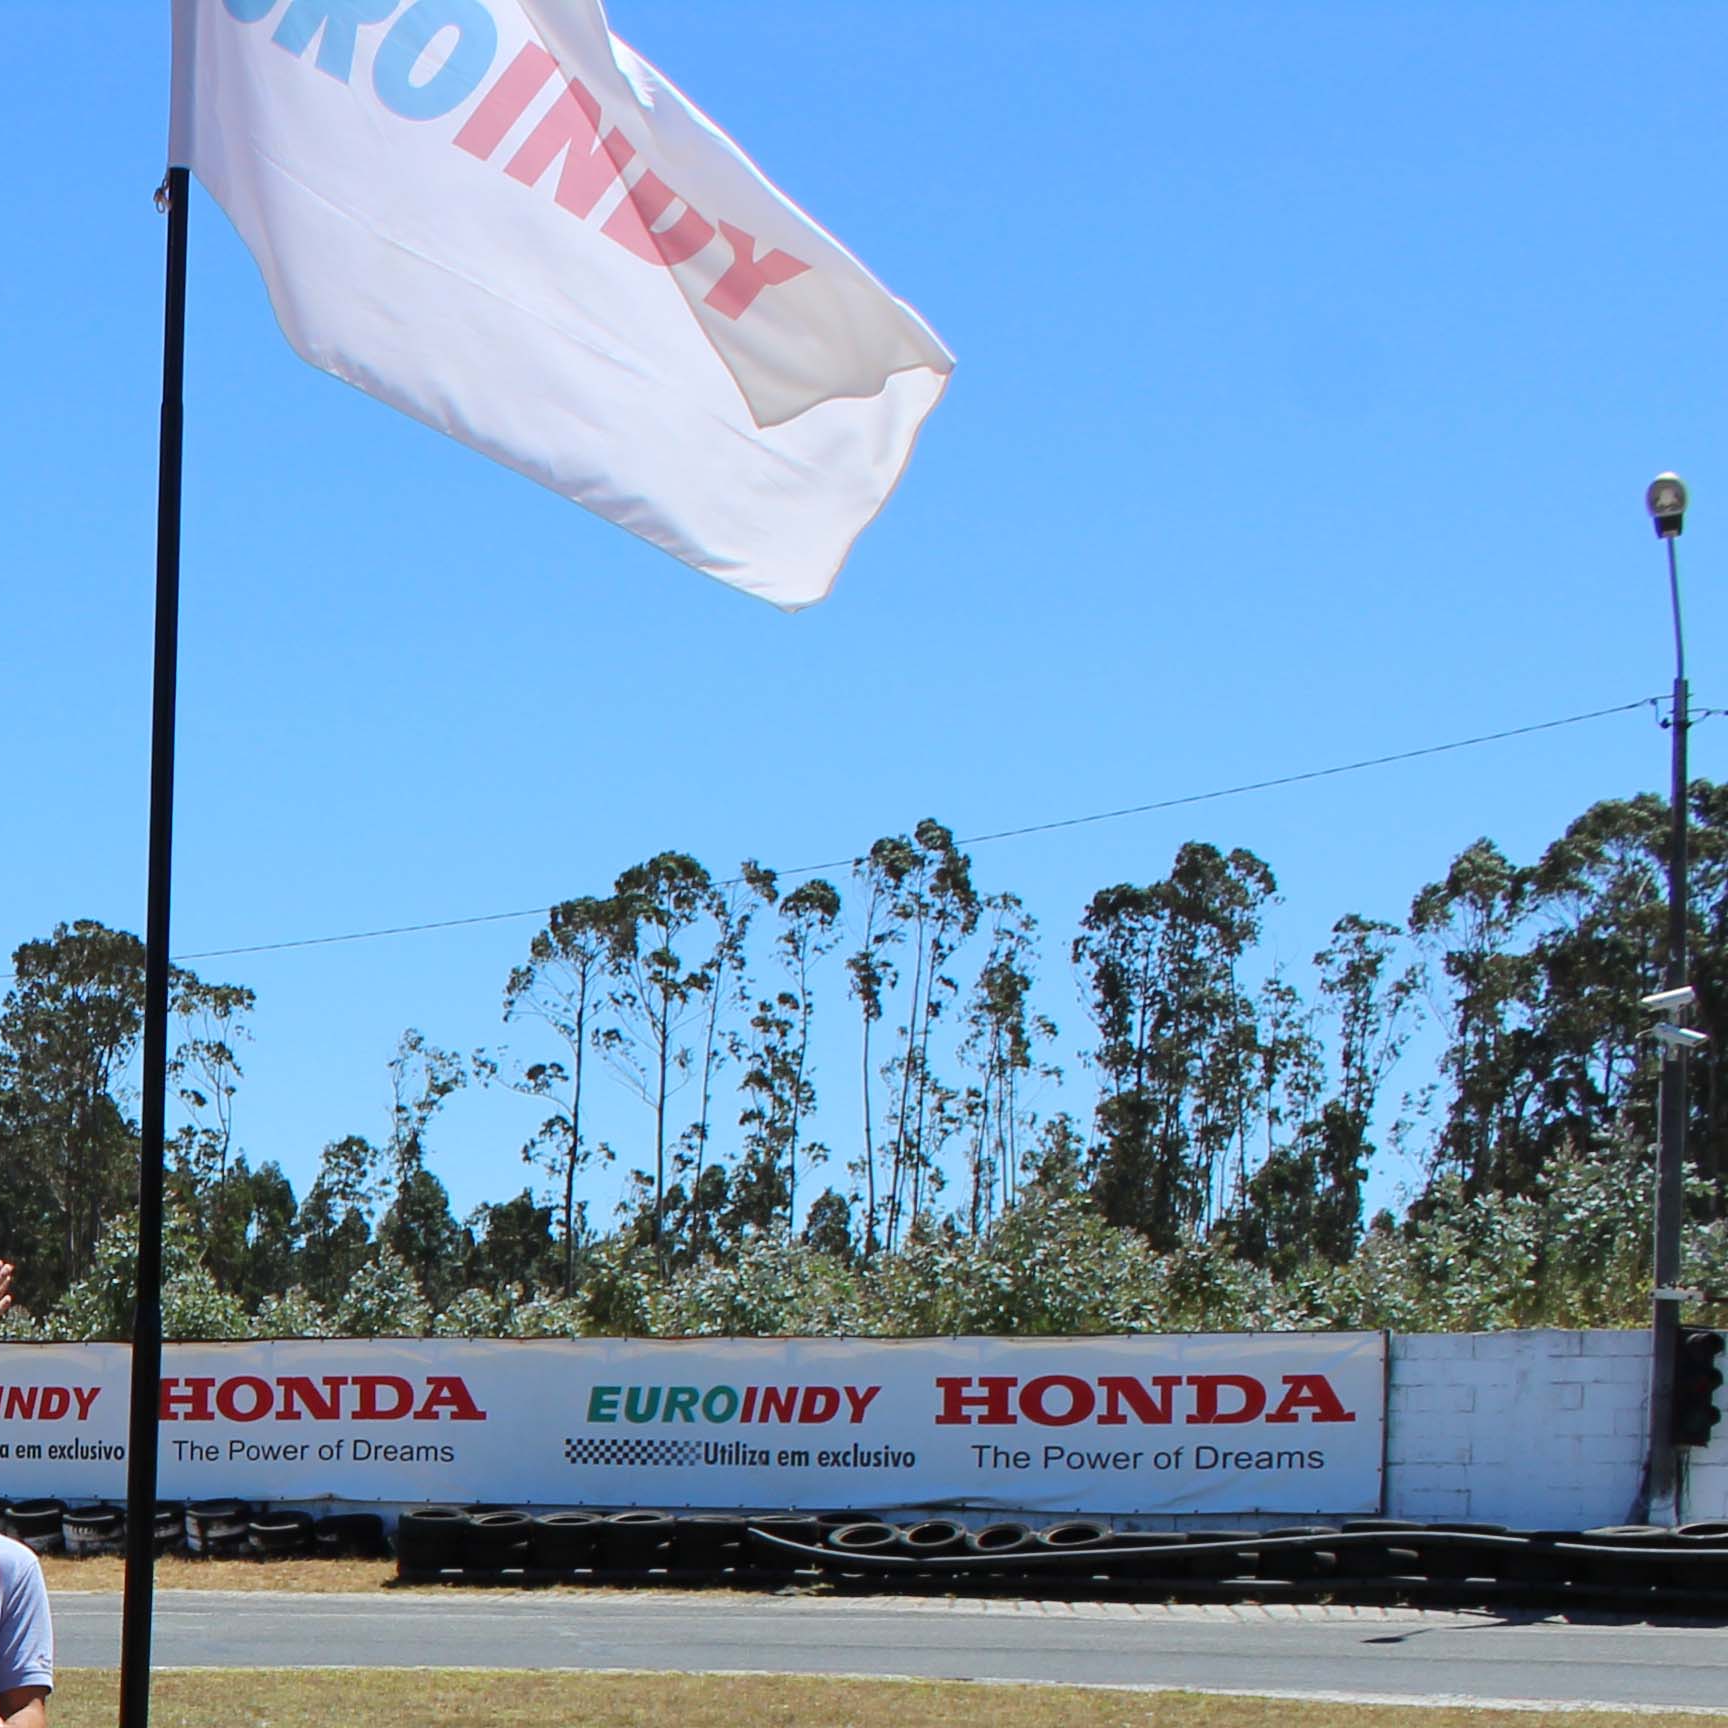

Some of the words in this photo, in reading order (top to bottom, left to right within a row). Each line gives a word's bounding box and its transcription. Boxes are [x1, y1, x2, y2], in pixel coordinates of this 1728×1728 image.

[158, 1376, 487, 1421] HONDA
[586, 1385, 882, 1424] EUROINDY
[935, 1373, 1356, 1426] HONDA
[16, 1443, 46, 1461] em
[47, 1438, 126, 1461] exclusivo
[175, 1439, 222, 1463] The
[228, 1439, 312, 1463] Power
[317, 1439, 345, 1463] of
[352, 1439, 455, 1463] Dreams
[703, 1440, 771, 1468] Utiliza
[777, 1447, 810, 1468] em
[816, 1441, 916, 1469] exclusivo
[972, 1444, 1032, 1470] The
[1042, 1444, 1144, 1470] Power
[1152, 1444, 1184, 1470] of
[1194, 1444, 1326, 1470] Dreams
